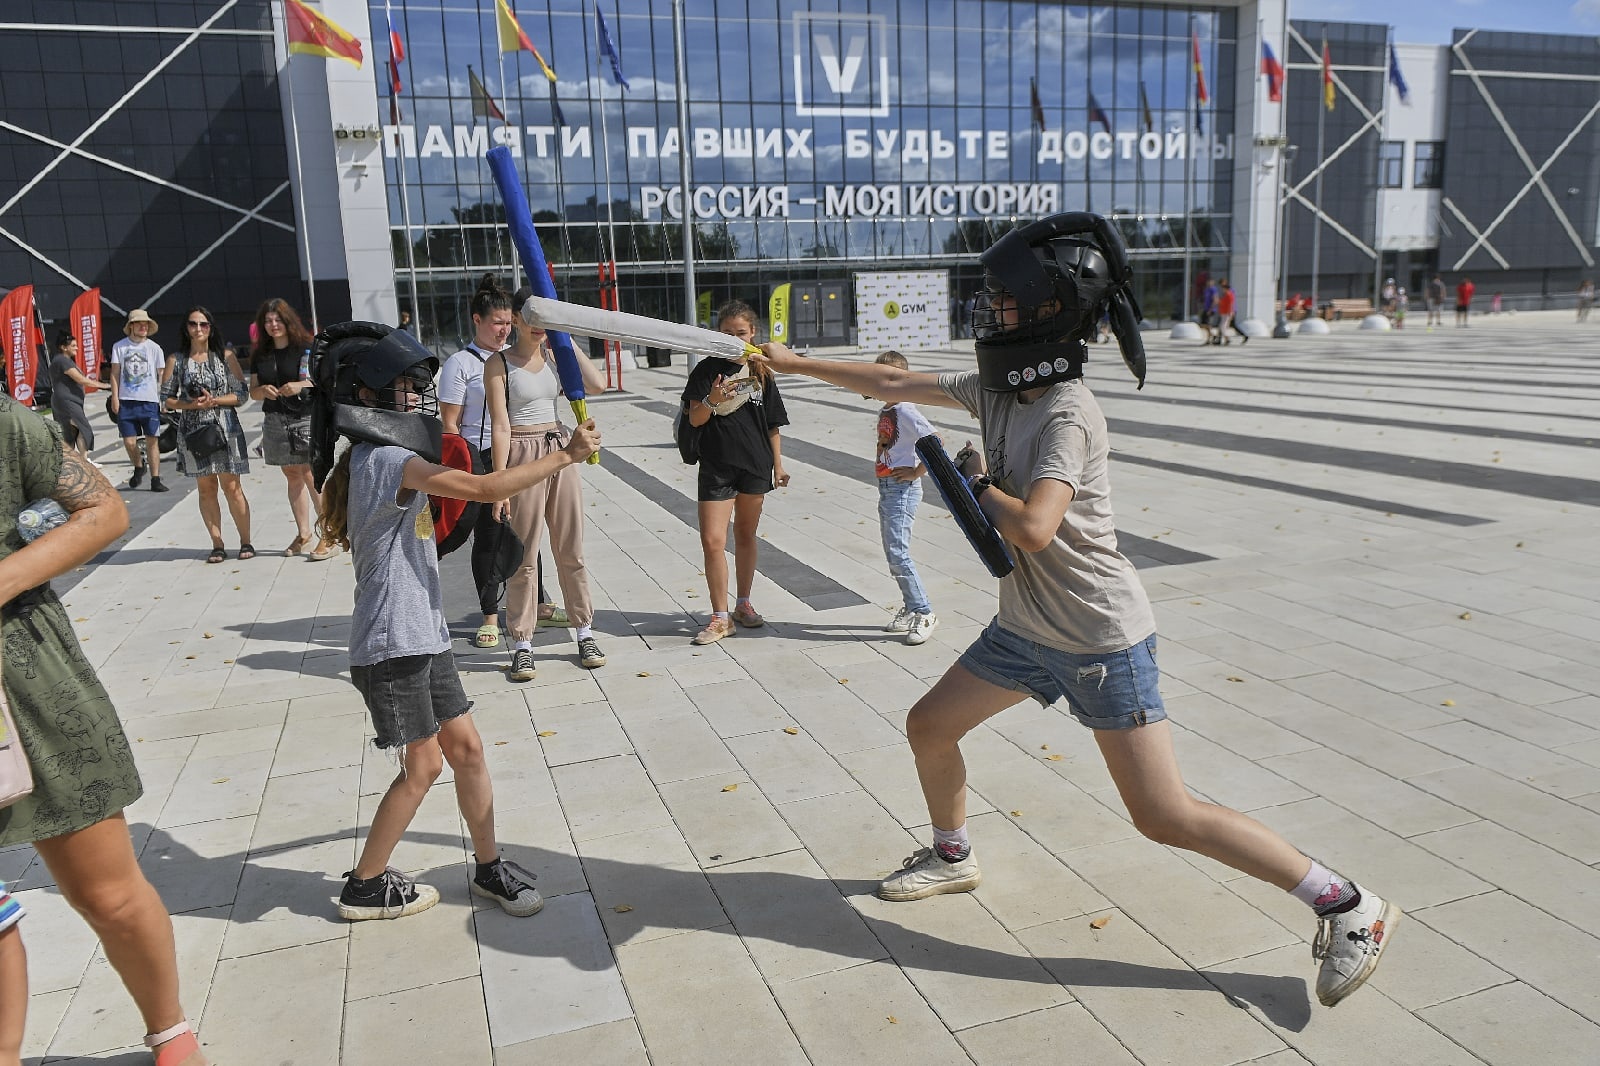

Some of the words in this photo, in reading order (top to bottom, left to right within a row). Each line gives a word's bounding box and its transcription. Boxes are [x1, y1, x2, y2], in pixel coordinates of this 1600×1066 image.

[383, 124, 591, 158] ПАМЯТИ
[627, 126, 813, 159] ПАВШИХ
[845, 128, 1009, 164] БУДЬТЕ
[1037, 125, 1234, 164] ДОСТОЙНЫ
[641, 185, 789, 219] РОССИЯ
[825, 184, 901, 217] МОЯ
[909, 183, 1059, 214] ИСТОРИЯ
[774, 297, 783, 320] GYM
[901, 303, 927, 315] GYM
